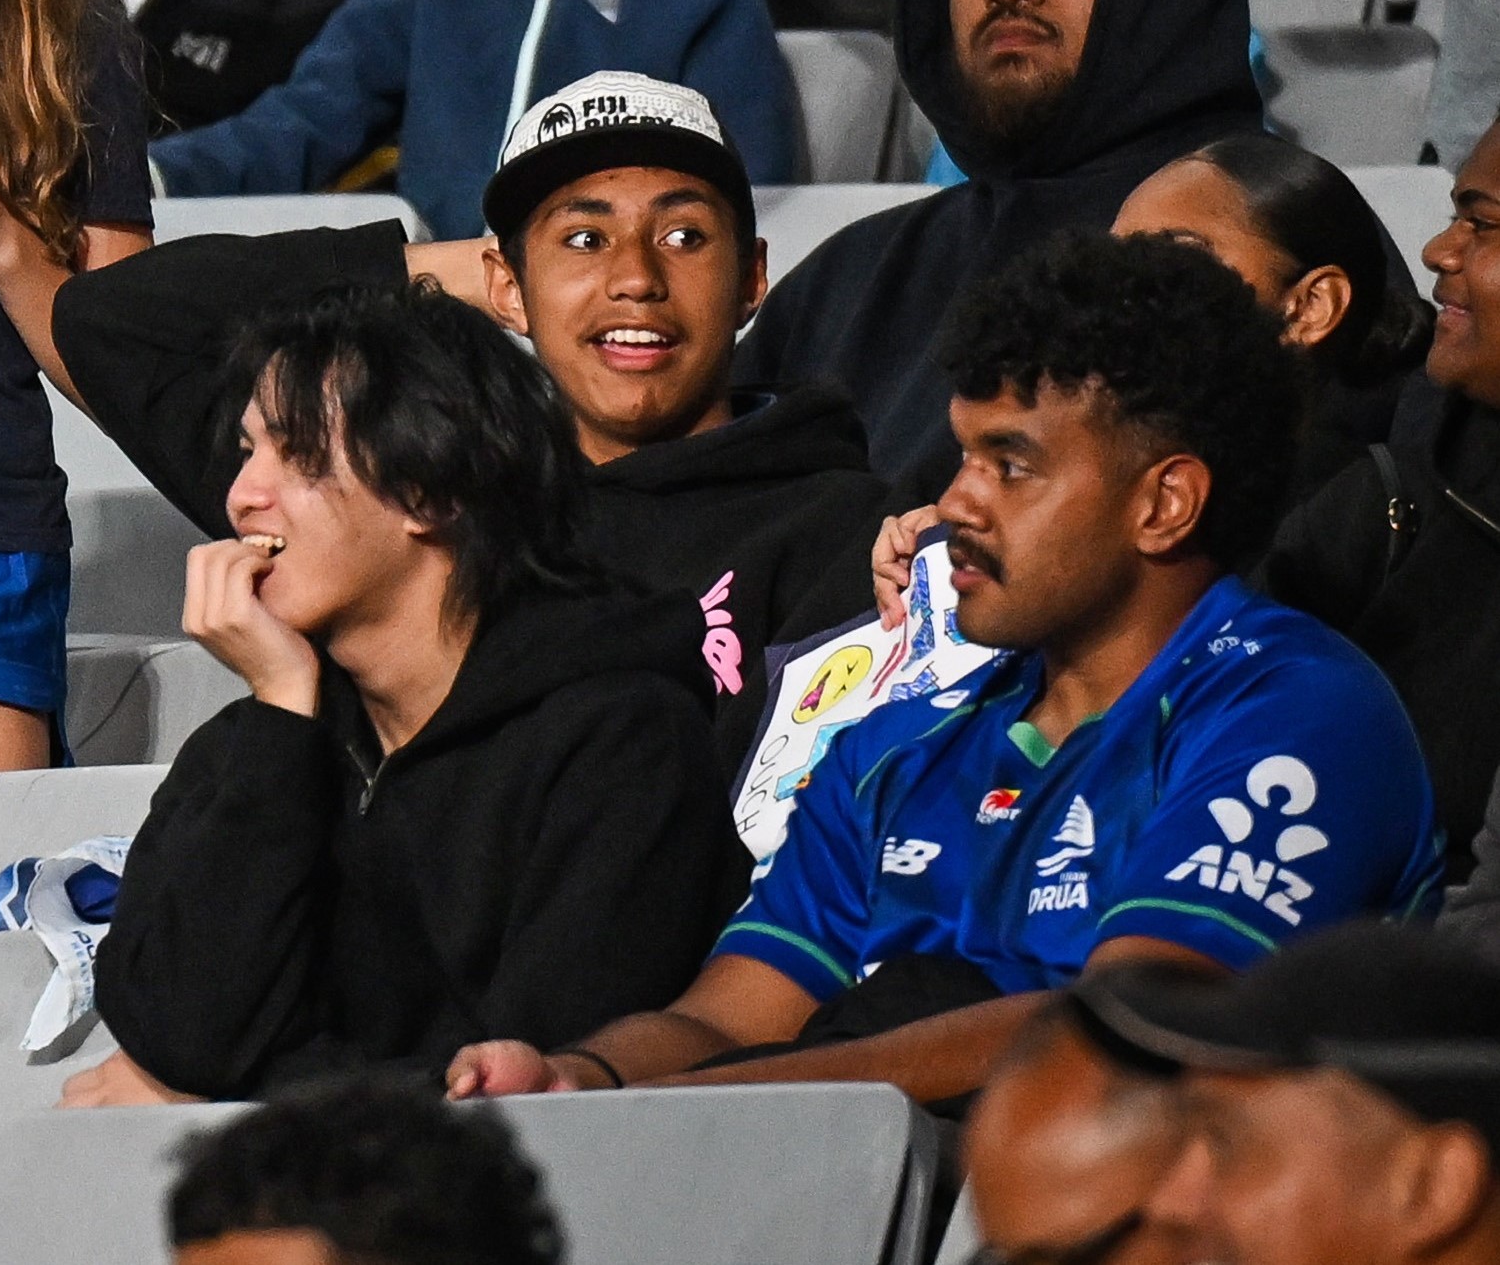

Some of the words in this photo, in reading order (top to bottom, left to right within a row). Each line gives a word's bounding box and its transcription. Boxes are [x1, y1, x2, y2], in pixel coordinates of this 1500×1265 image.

[583, 95, 627, 117] FIJI
[736, 734, 789, 834] OUCH
[1028, 883, 1089, 916] DRUA
[1164, 845, 1314, 927] ANZ
